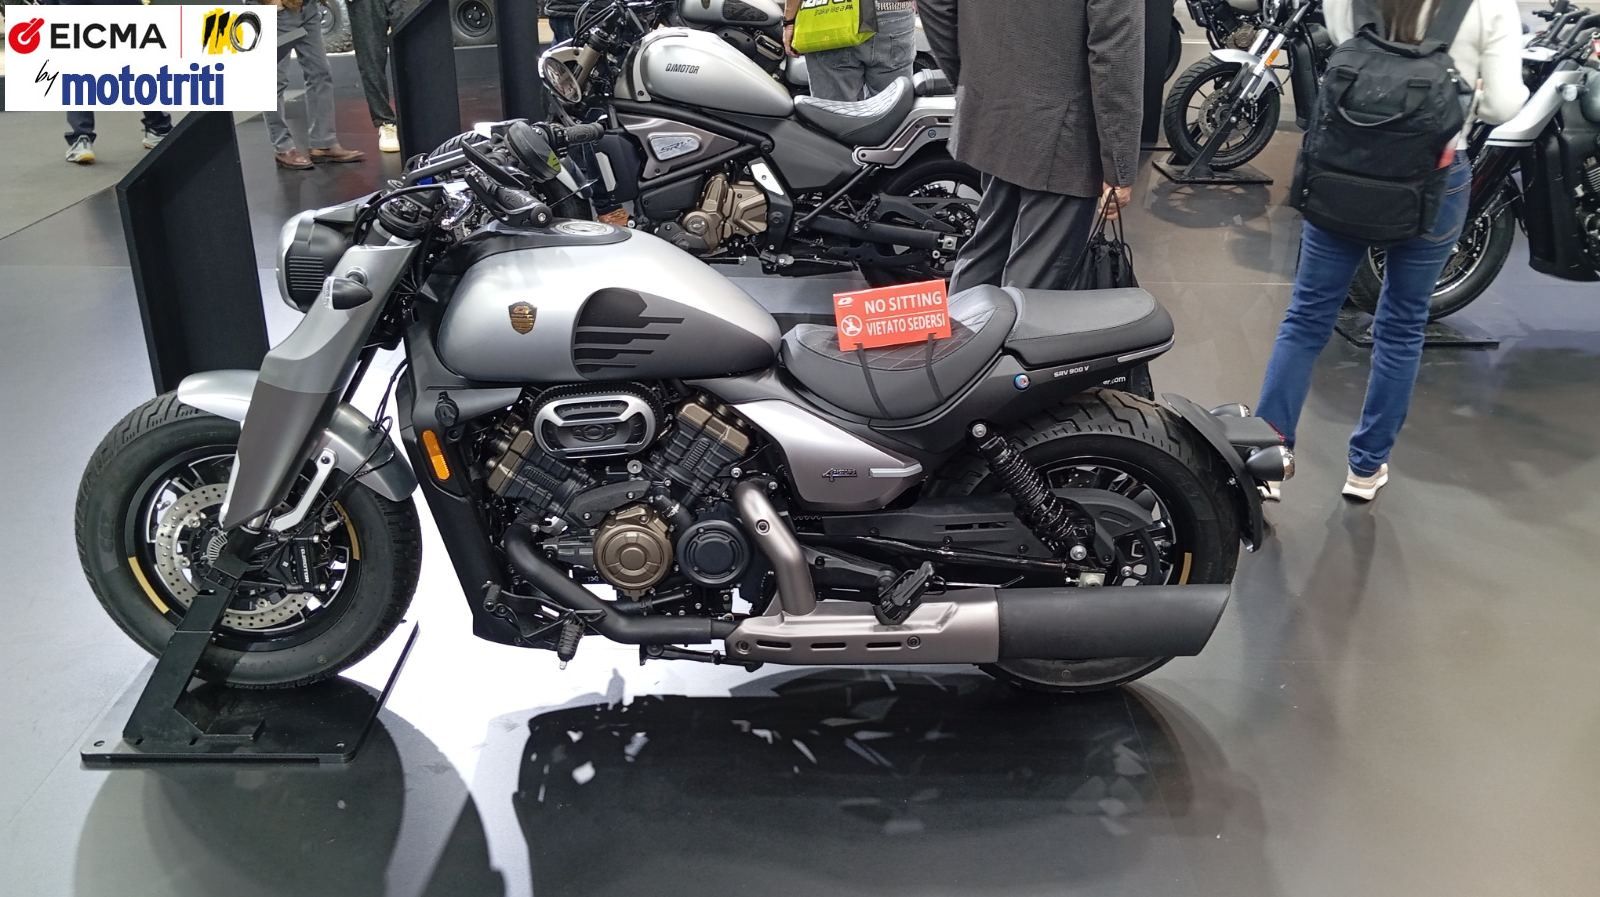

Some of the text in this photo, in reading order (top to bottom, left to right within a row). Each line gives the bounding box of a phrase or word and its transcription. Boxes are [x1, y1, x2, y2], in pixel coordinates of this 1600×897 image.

[665, 63, 700, 75] QJMOTOR
[864, 290, 943, 315] NO SITTING
[866, 313, 946, 337] VIETATO SEDERSI
[1053, 369, 1068, 378] SRV
